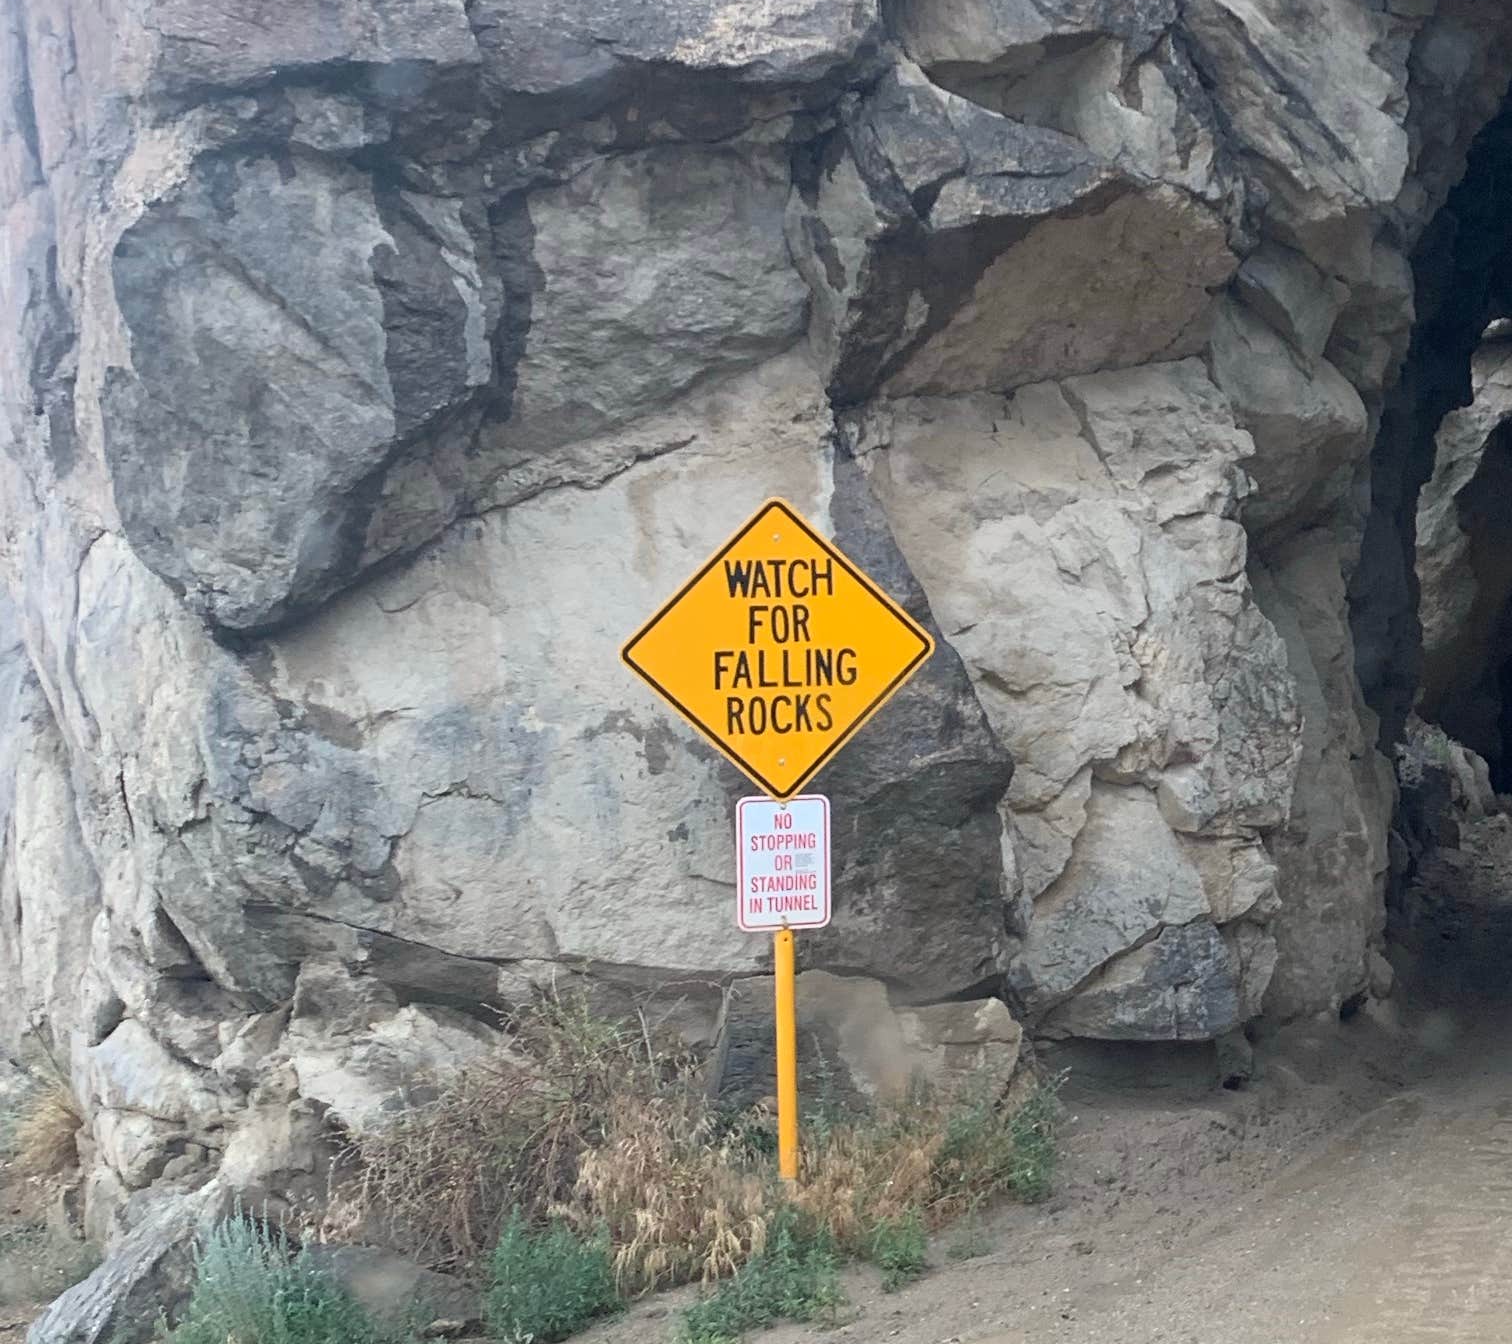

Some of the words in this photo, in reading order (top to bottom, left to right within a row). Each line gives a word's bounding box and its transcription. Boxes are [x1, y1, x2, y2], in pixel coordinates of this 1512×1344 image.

[723, 559, 834, 599] WATCH
[748, 605, 811, 644] FOR
[713, 648, 858, 690] FALLING
[727, 694, 834, 735] ROCKS
[774, 813, 792, 829] NO
[751, 833, 816, 851] STOPPING
[775, 855, 792, 870] OR
[751, 874, 817, 893] STANDING
[750, 898, 762, 913] IN
[767, 894, 818, 912] TUNNEL
